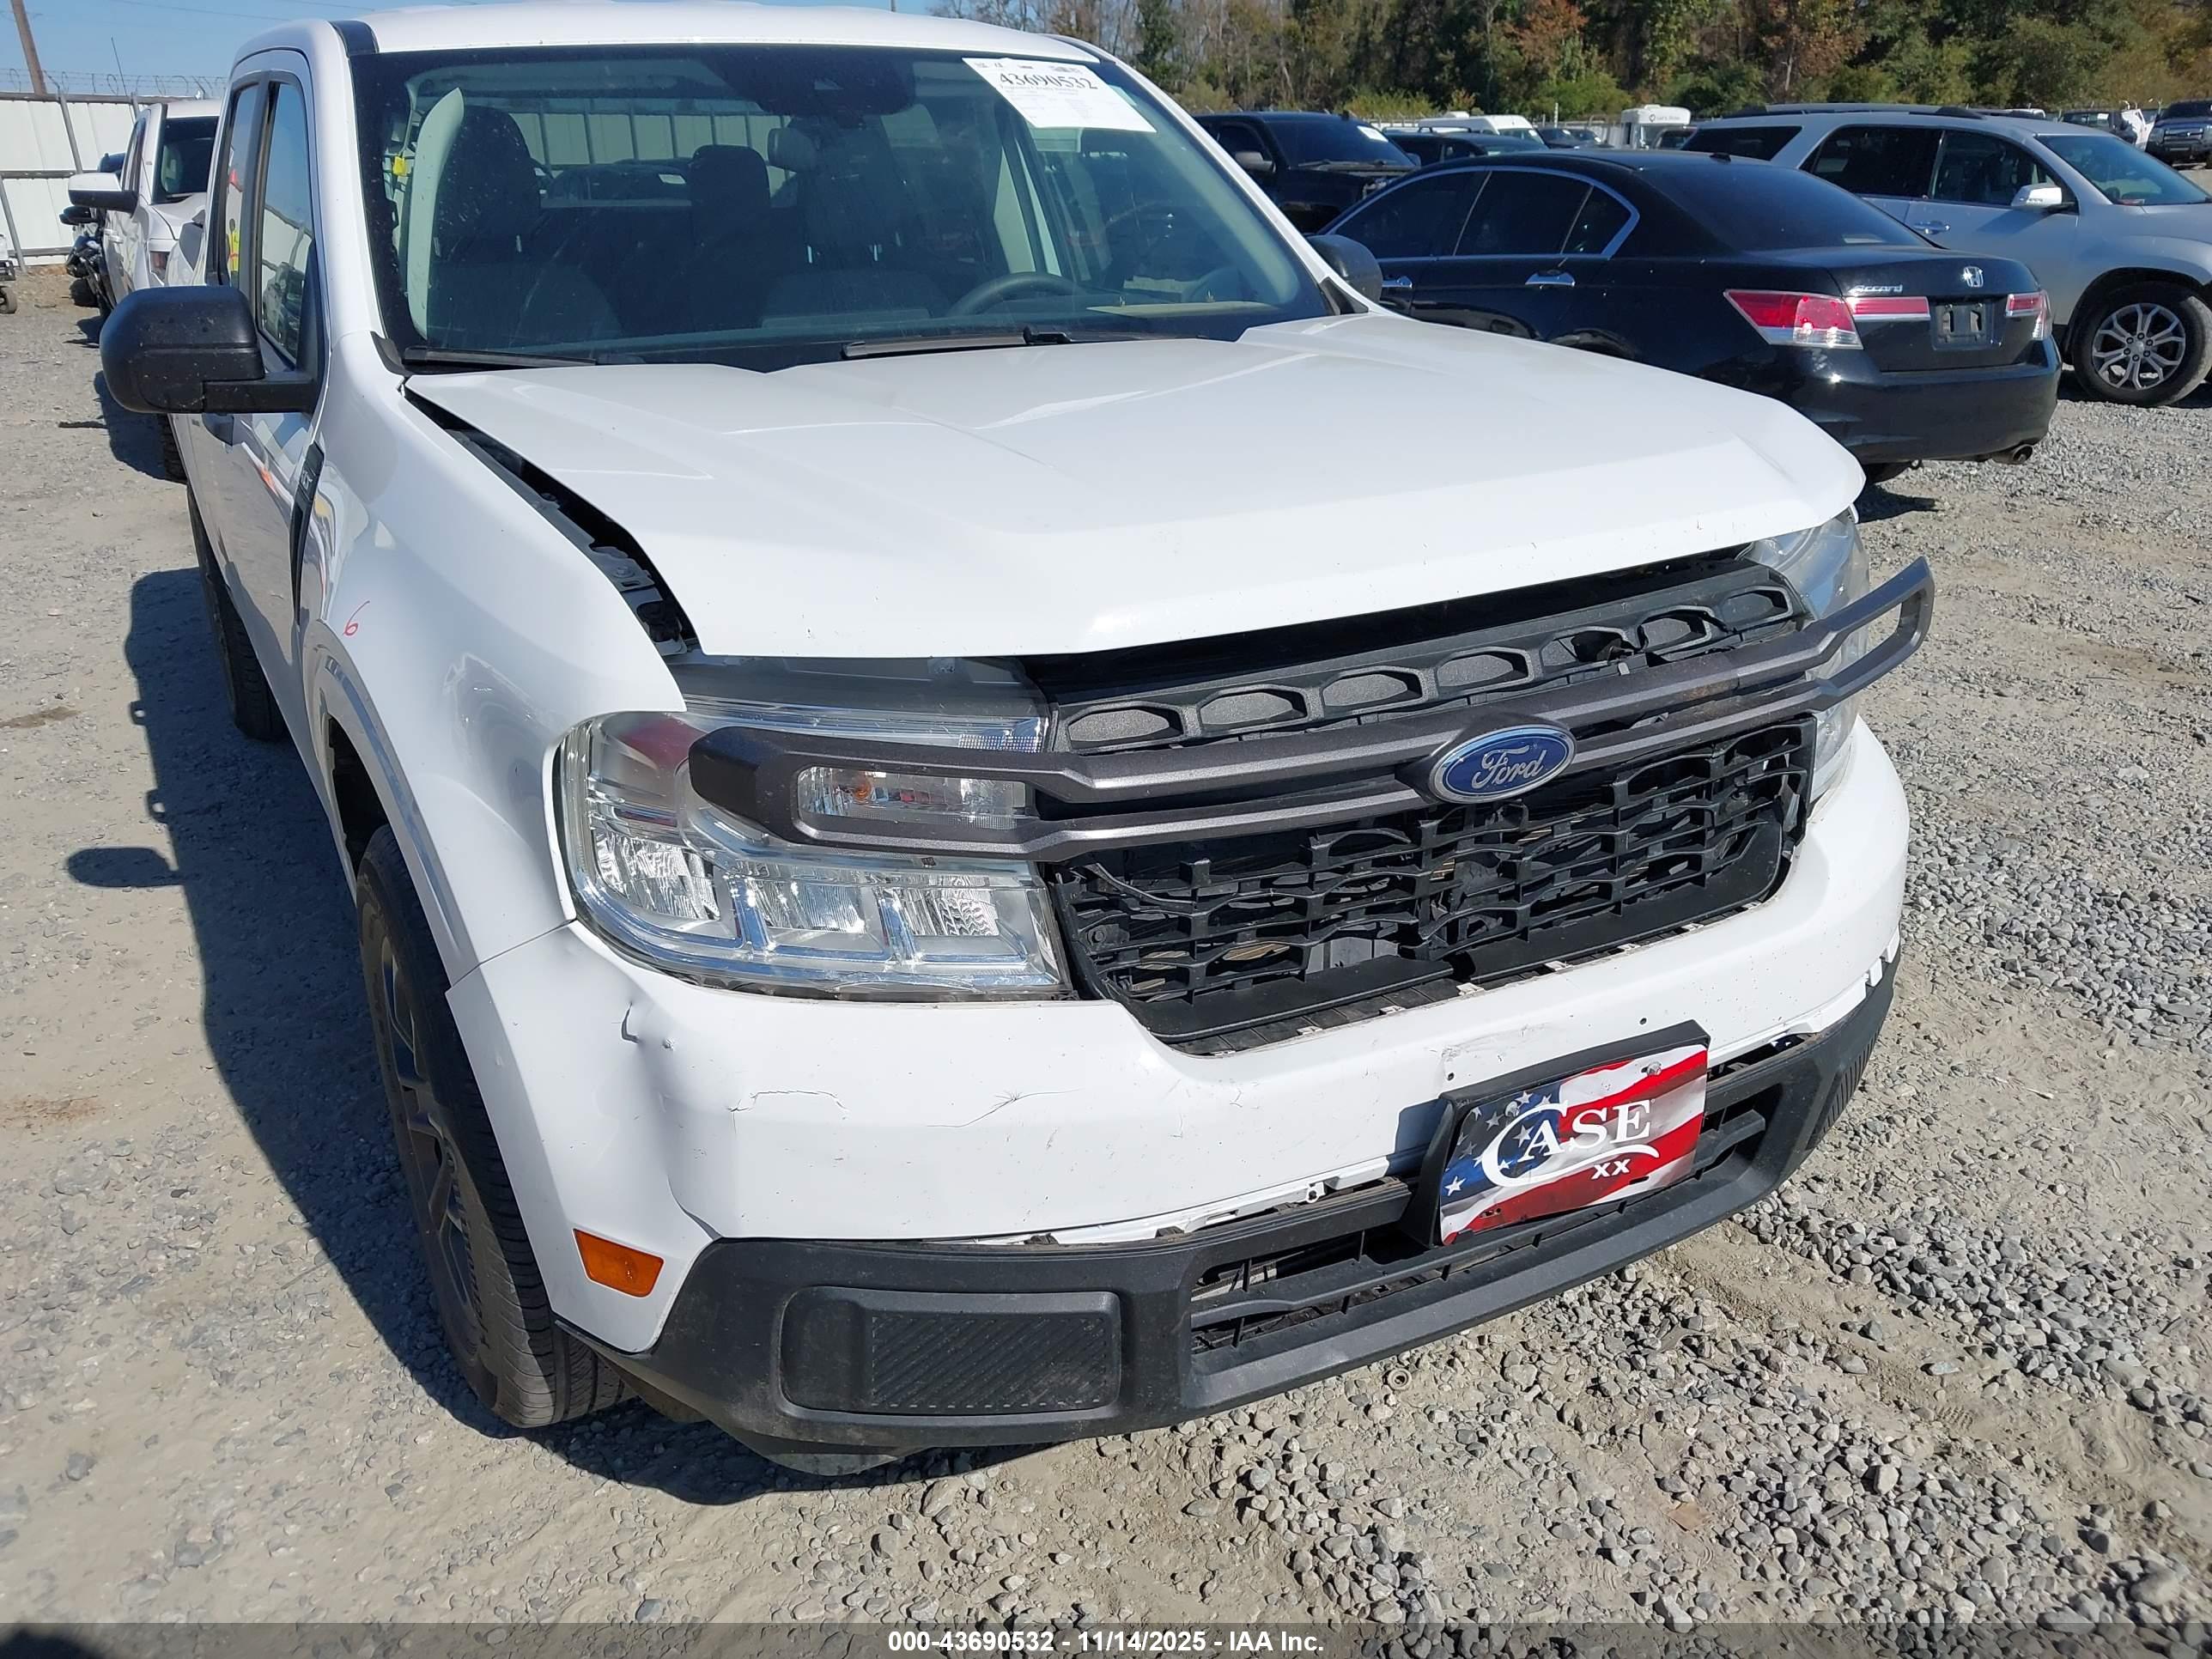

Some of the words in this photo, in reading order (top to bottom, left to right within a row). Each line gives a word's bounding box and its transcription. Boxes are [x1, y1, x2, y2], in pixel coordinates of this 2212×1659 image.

[1000, 72, 1098, 89] 43690532
[1849, 284, 1904, 294] Accord
[343, 600, 370, 636] 6
[1472, 745, 1547, 789] Ford
